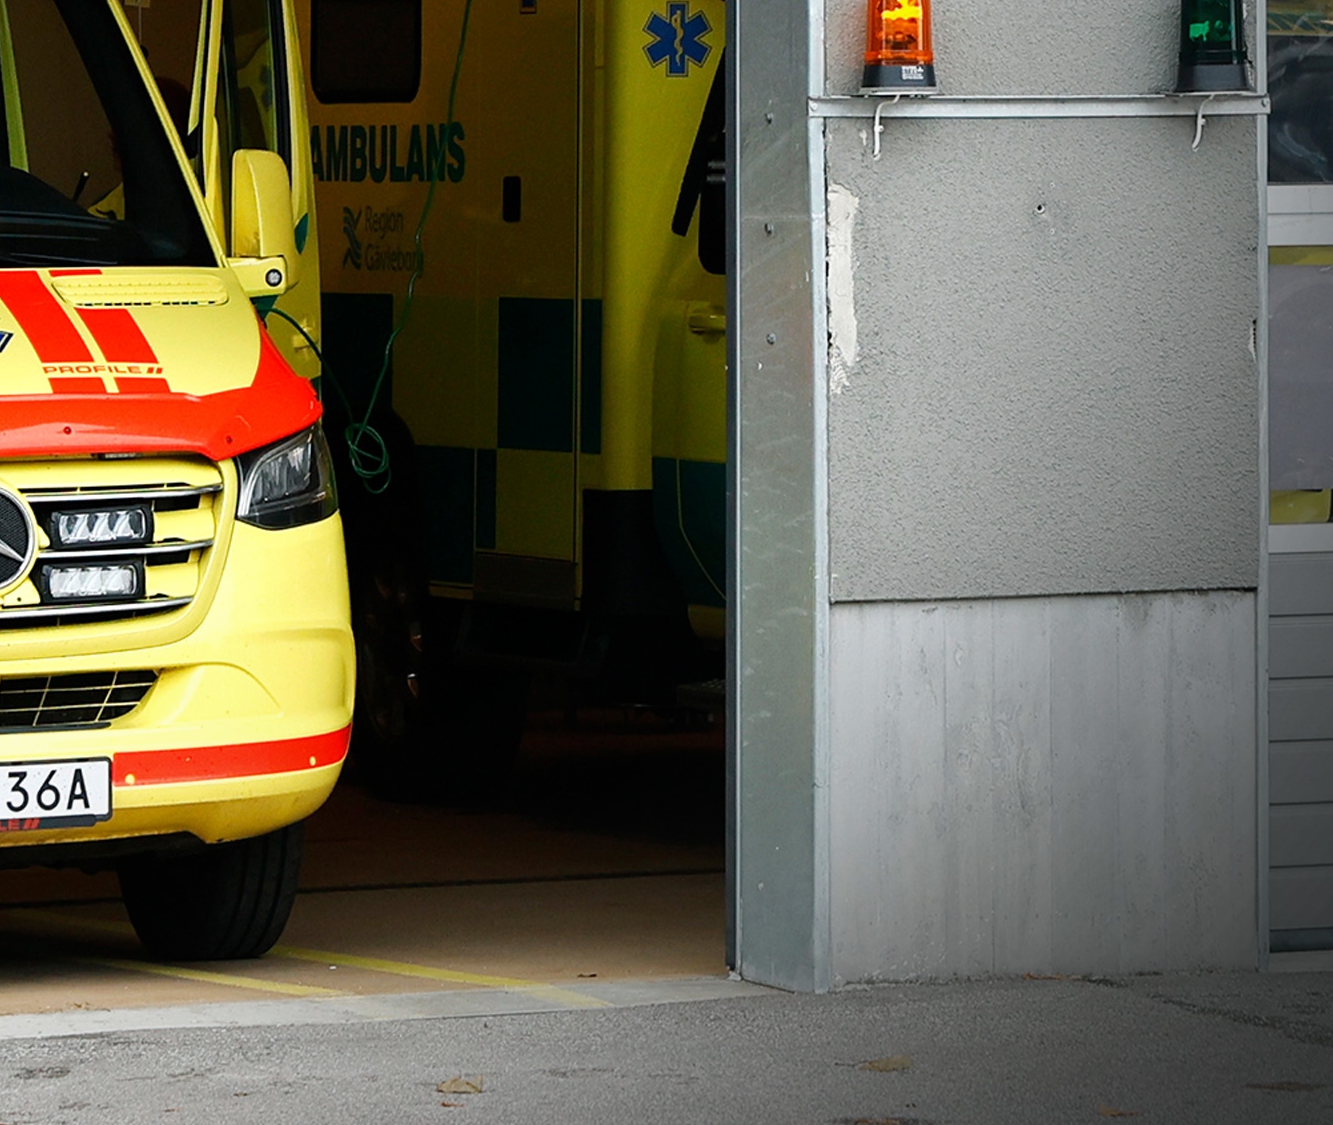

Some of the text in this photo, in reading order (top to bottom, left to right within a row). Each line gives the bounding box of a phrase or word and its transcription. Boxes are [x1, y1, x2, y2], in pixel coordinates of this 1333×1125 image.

[310, 121, 466, 184] AMBULANS
[364, 205, 404, 239] Region
[42, 365, 143, 375] PROFILE
[6, 767, 91, 813] 36A
